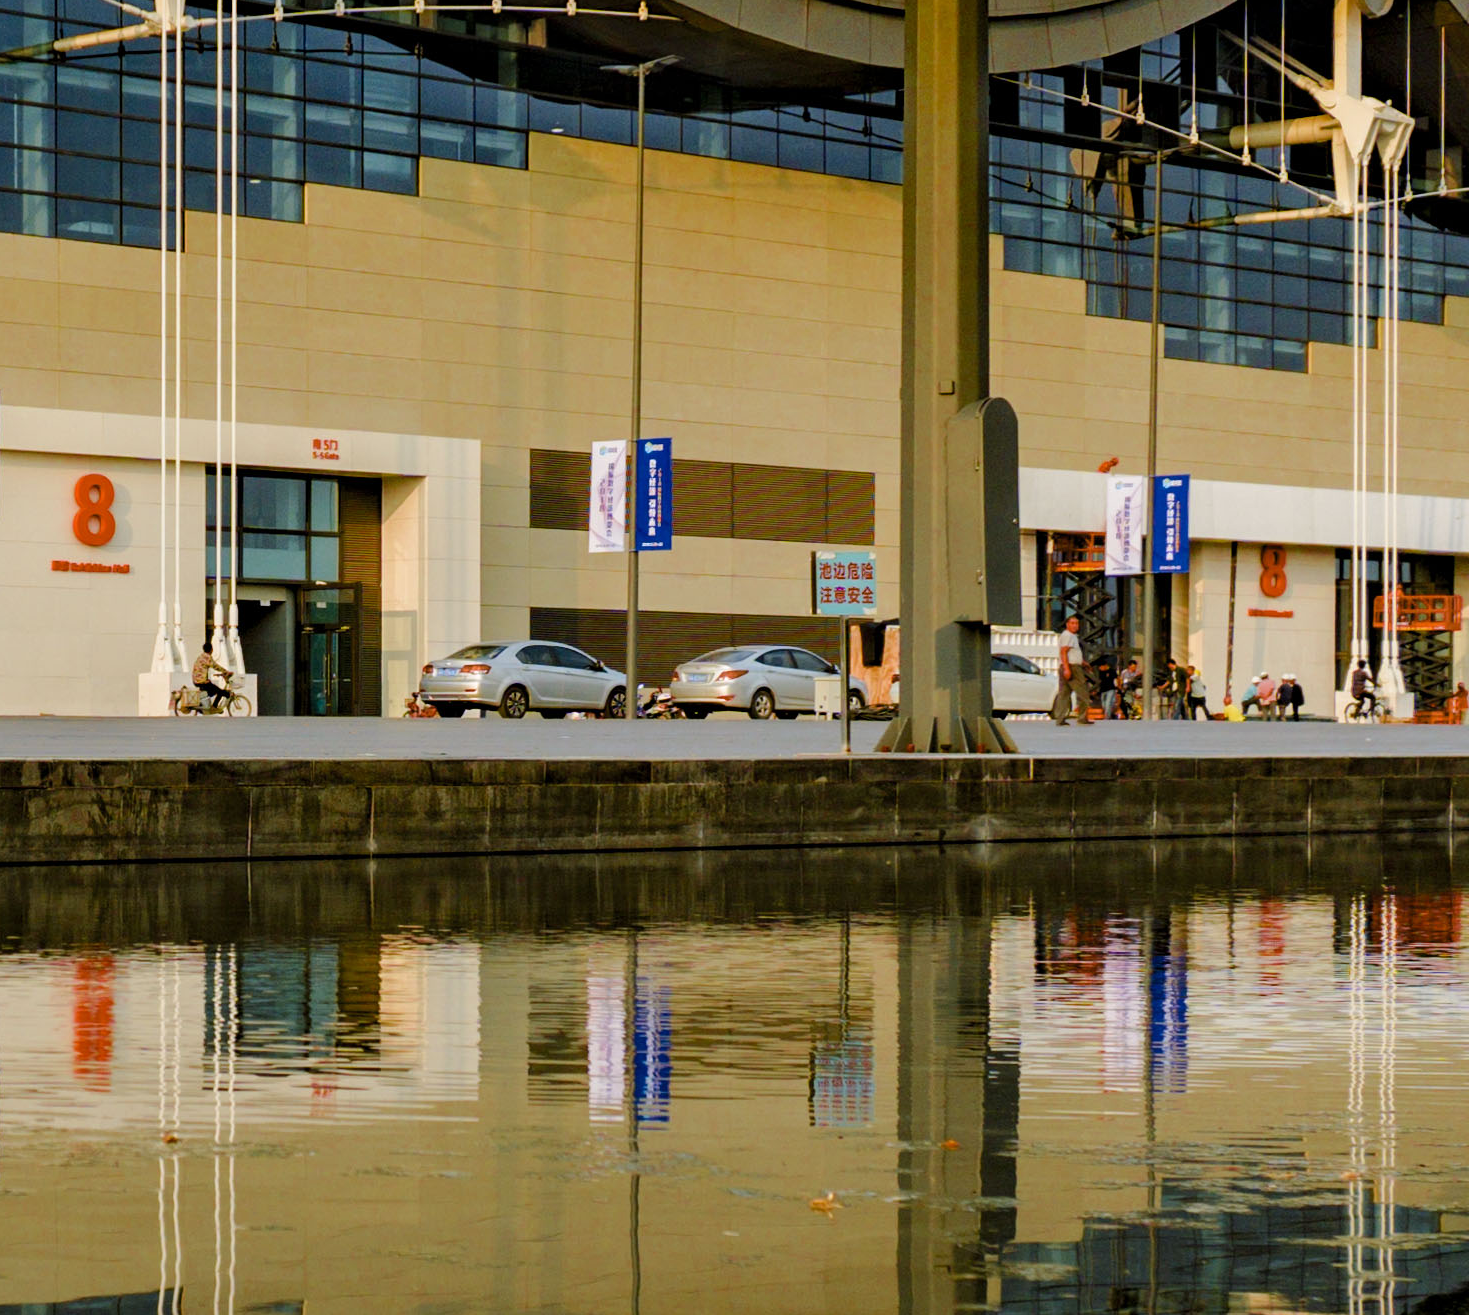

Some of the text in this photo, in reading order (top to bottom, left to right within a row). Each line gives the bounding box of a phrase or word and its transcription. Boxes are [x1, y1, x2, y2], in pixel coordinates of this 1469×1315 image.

[72, 473, 116, 547] 8
[819, 562, 873, 580] 池边危险
[1260, 544, 1287, 598] 8
[820, 585, 874, 604] 注意安全
